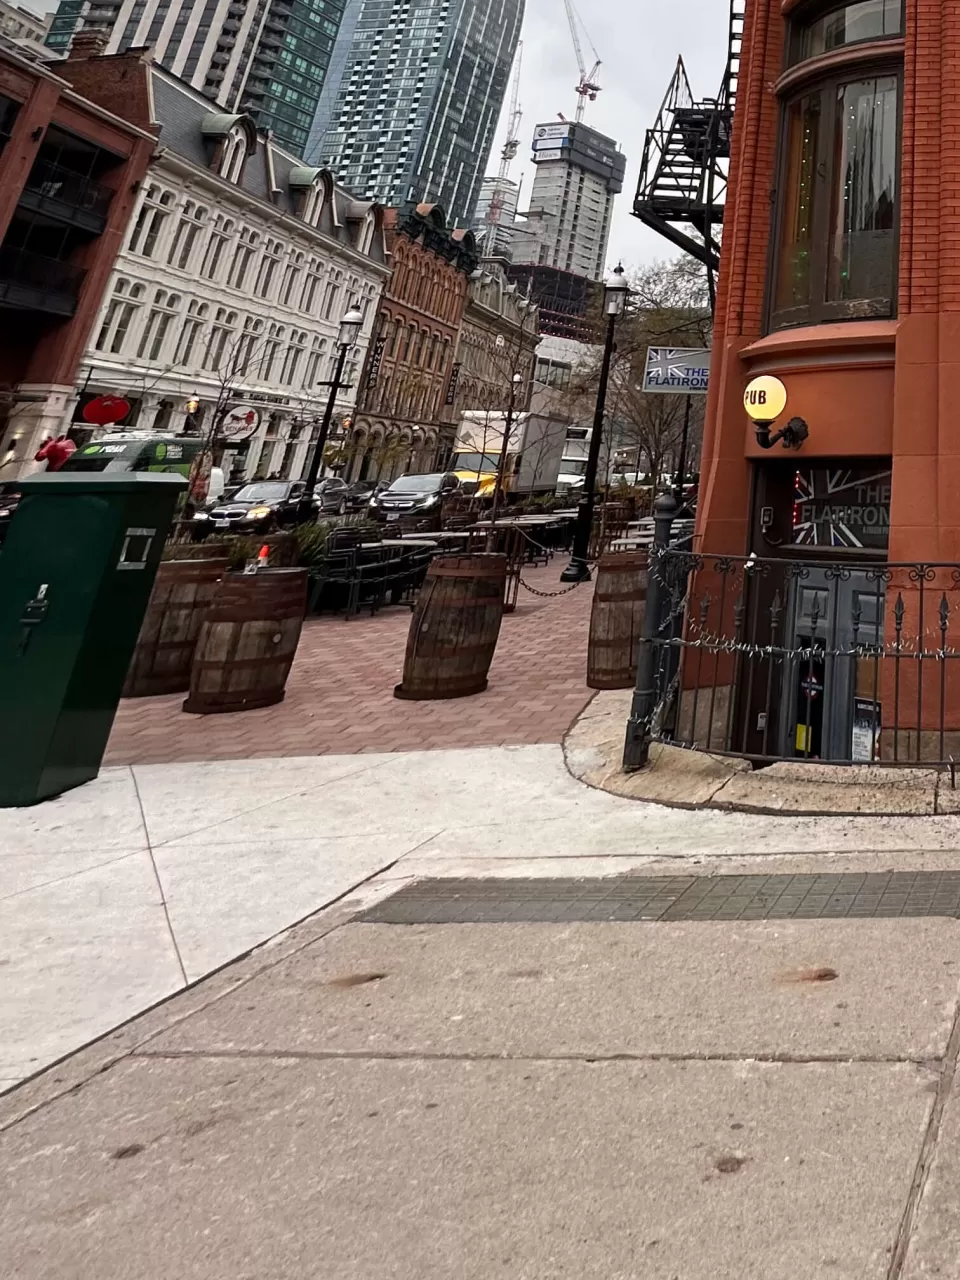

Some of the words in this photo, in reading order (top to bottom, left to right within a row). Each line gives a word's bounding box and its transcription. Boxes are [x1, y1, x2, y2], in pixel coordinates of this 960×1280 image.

[370, 341, 385, 387] WINNERS
[684, 367, 709, 376] THE
[648, 377, 709, 387] FLATIRON
[745, 389, 767, 405] PUB
[854, 485, 890, 504] THE
[801, 505, 890, 526] FLATIRON
